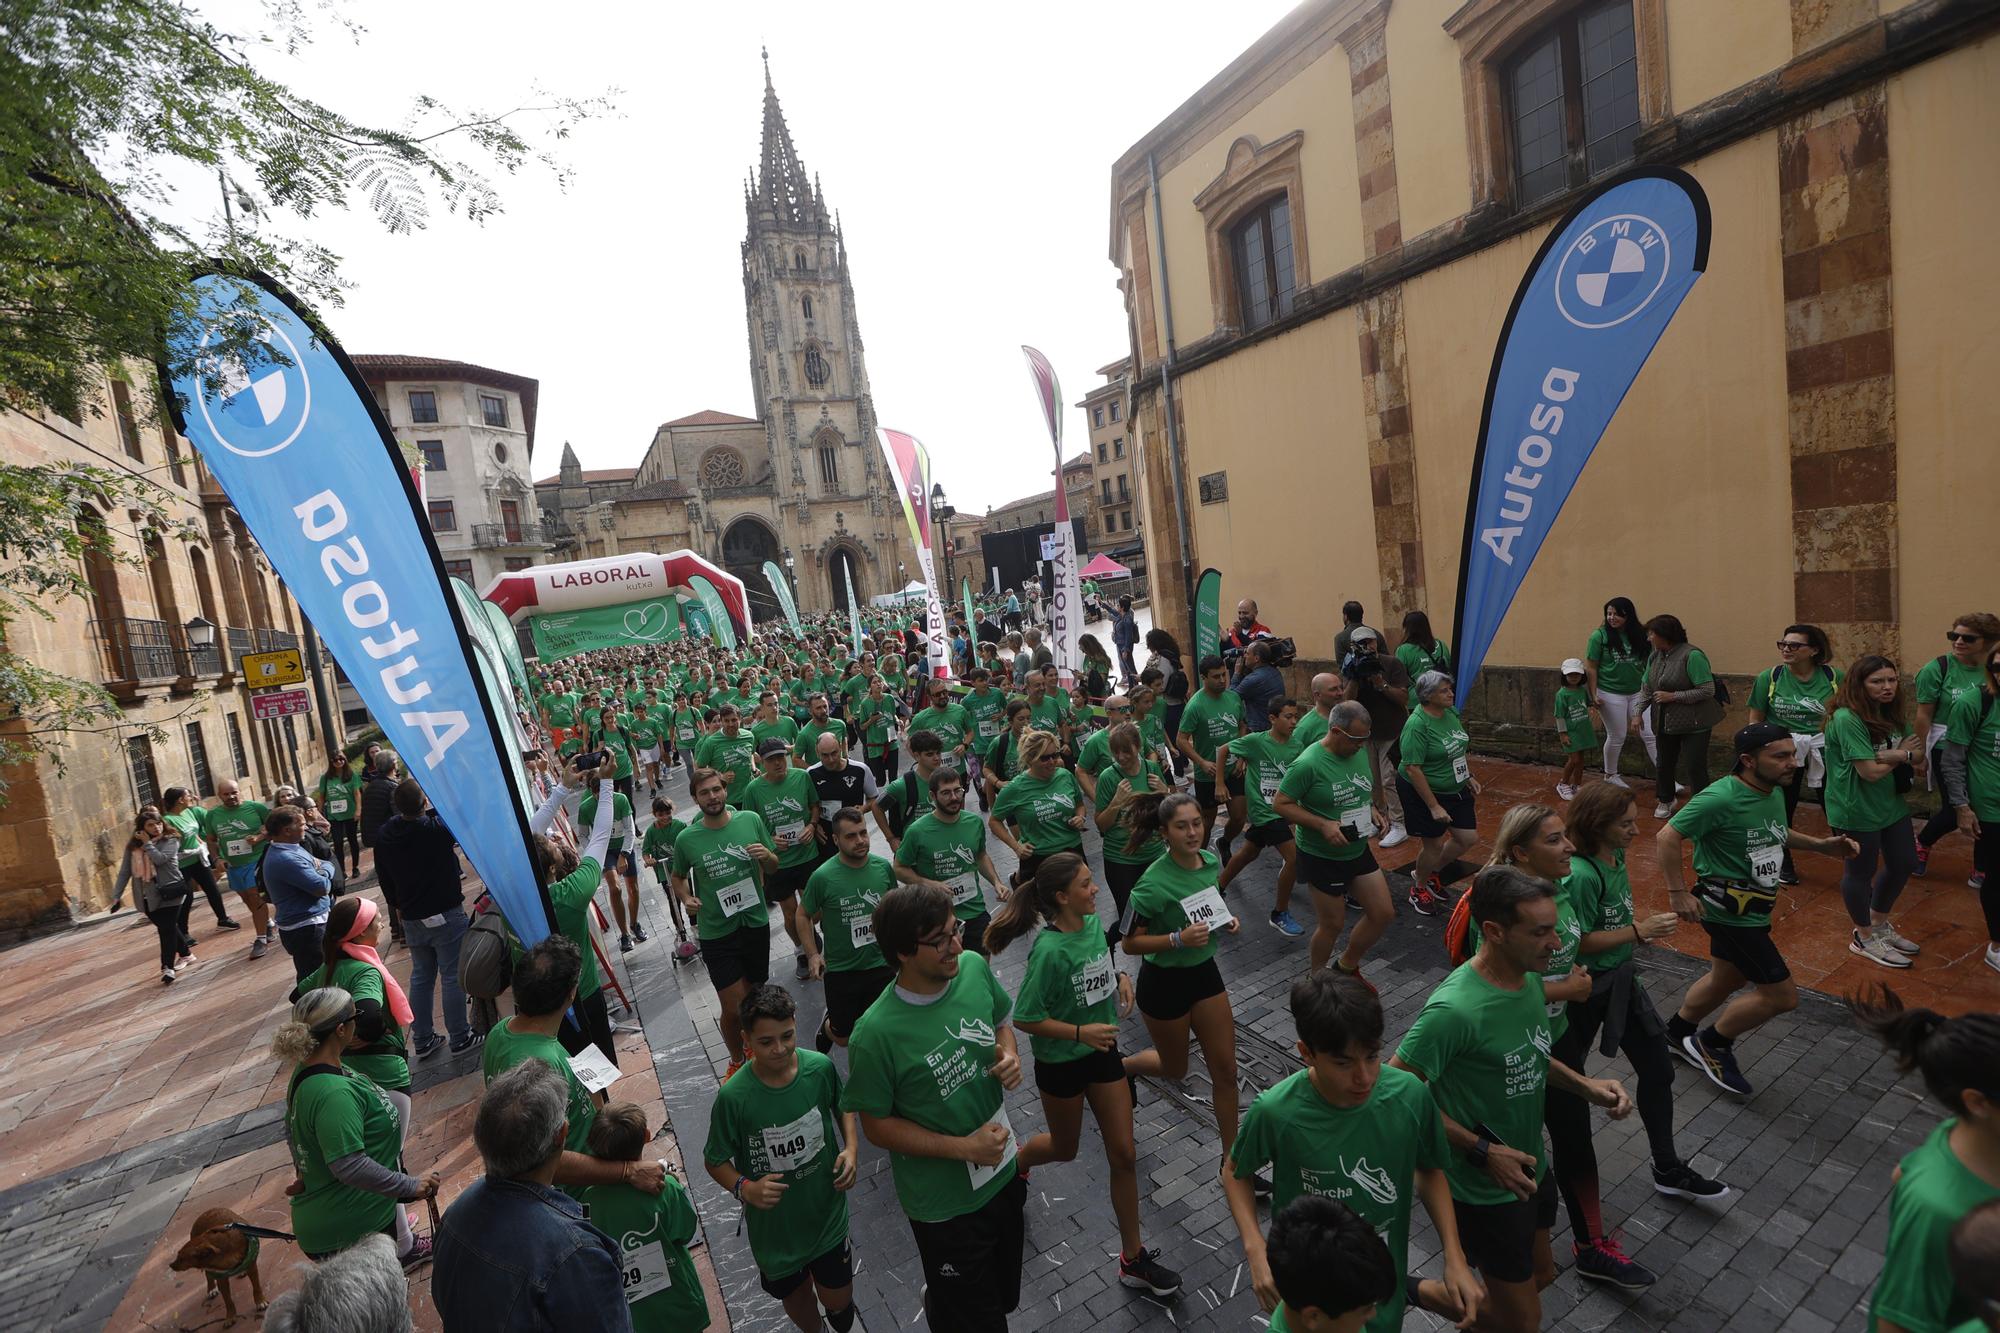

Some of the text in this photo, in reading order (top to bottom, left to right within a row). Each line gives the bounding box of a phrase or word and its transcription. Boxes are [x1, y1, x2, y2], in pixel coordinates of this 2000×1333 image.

[1578, 221, 1660, 255] BMW
[1481, 366, 1581, 567] Autosa
[550, 565, 651, 589] LABORAL
[626, 582, 653, 592] kutxa
[1055, 532, 1068, 671] LABORAL
[253, 652, 289, 663] OFICINA
[251, 673, 300, 687] DE TURISMO
[1332, 783, 1341, 791] En
[1747, 830, 1759, 838] En
[704, 855, 728, 867] marcha
[707, 863, 727, 873] contra
[1755, 861, 1777, 876] 1492
[715, 865, 737, 876] cáncer
[723, 893, 743, 908] 1707
[841, 902, 865, 911] marcha
[841, 909, 863, 917] contra
[1189, 904, 1214, 923] 2146
[1605, 908, 1617, 917] En
[1086, 970, 1110, 992] 2260
[926, 1051, 943, 1068] En
[932, 1045, 967, 1078] marcha
[1505, 1054, 1521, 1066] En
[936, 1058, 967, 1086] contra
[940, 1059, 978, 1097] el cáncer
[1506, 1084, 1516, 1095] el
[769, 1136, 806, 1158] 1449
[1301, 1168, 1319, 1184] En
[1303, 1182, 1352, 1199] marcha
